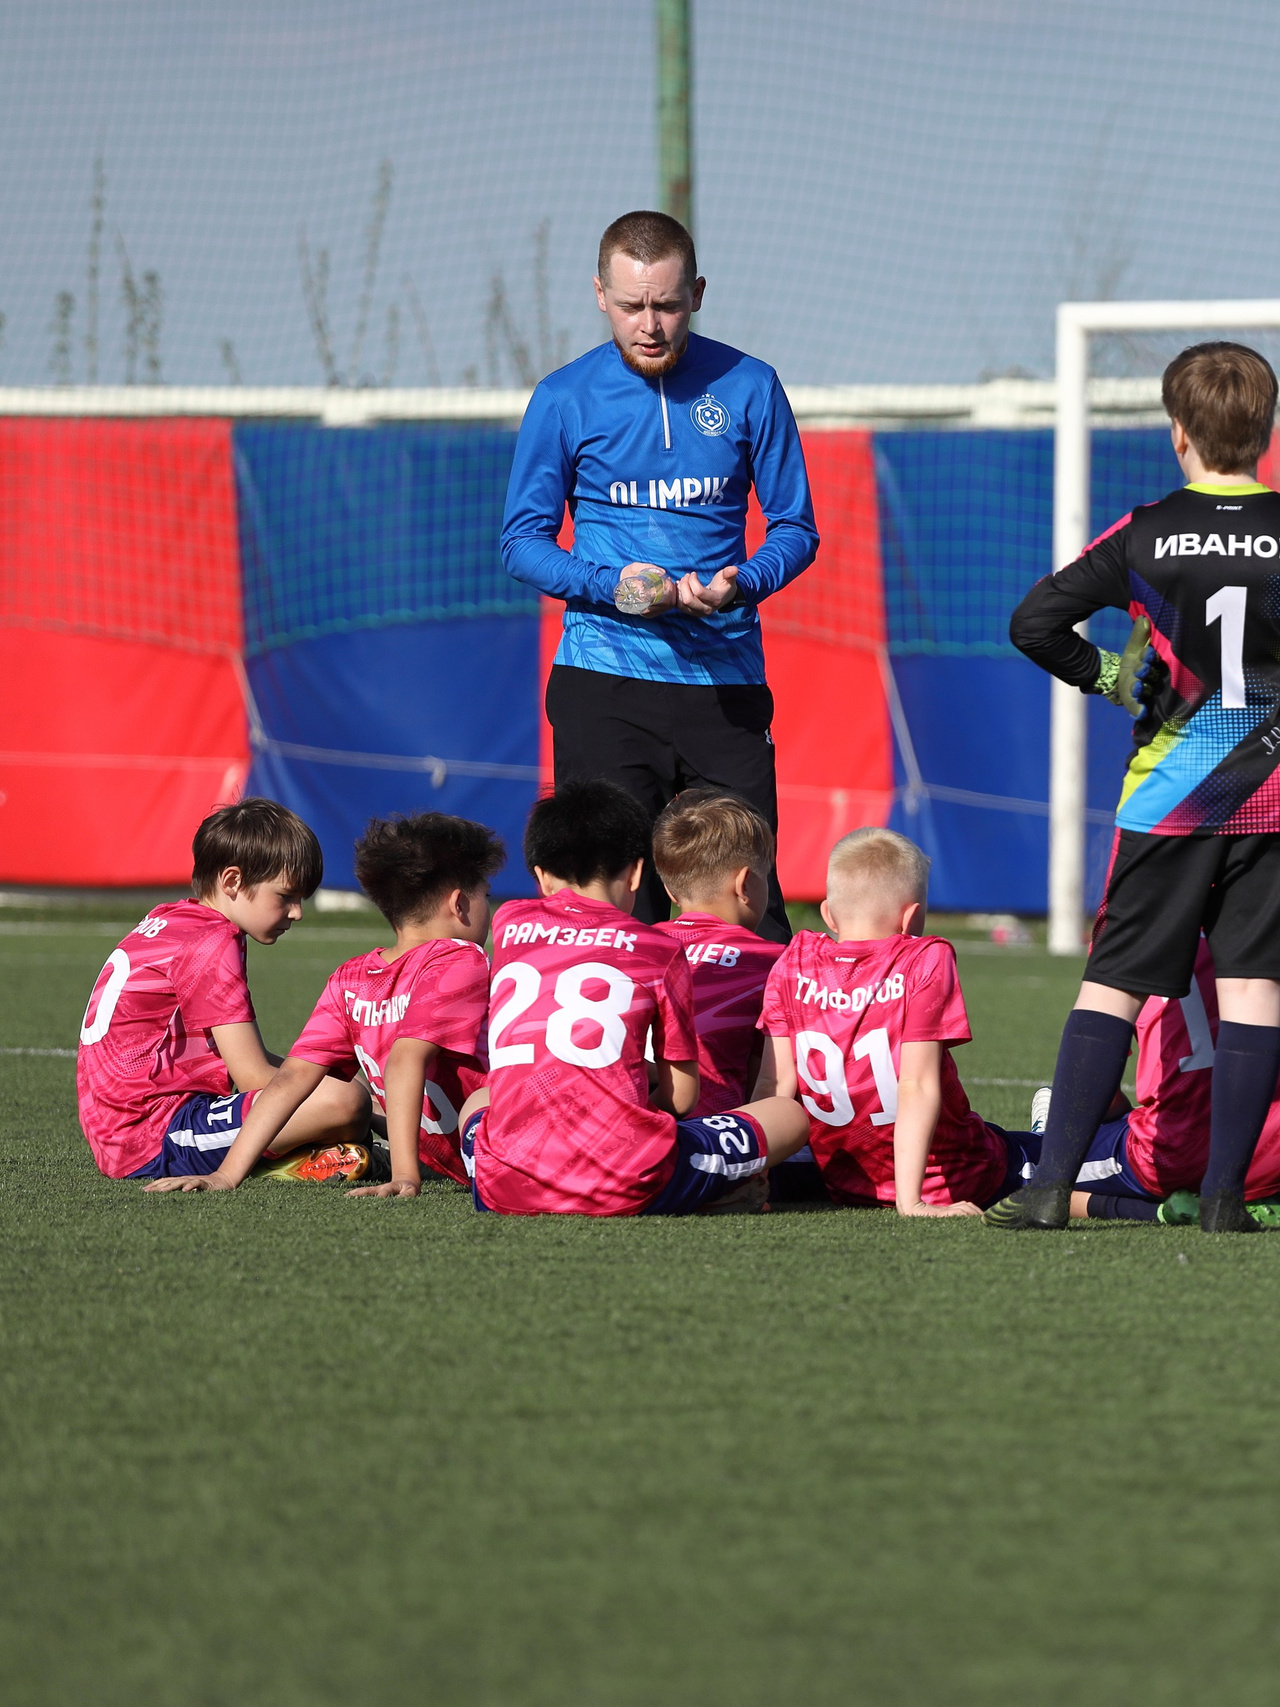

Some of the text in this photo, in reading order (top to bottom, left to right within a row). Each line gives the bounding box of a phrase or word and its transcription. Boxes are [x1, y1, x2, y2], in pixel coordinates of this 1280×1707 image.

[609, 476, 729, 509] OLIMPIK
[1205, 585, 1248, 709] 1
[501, 922, 638, 953] РАМЗБЕК
[487, 961, 635, 1080] 28
[795, 1027, 900, 1128] 91
[702, 1114, 751, 1155] 28
